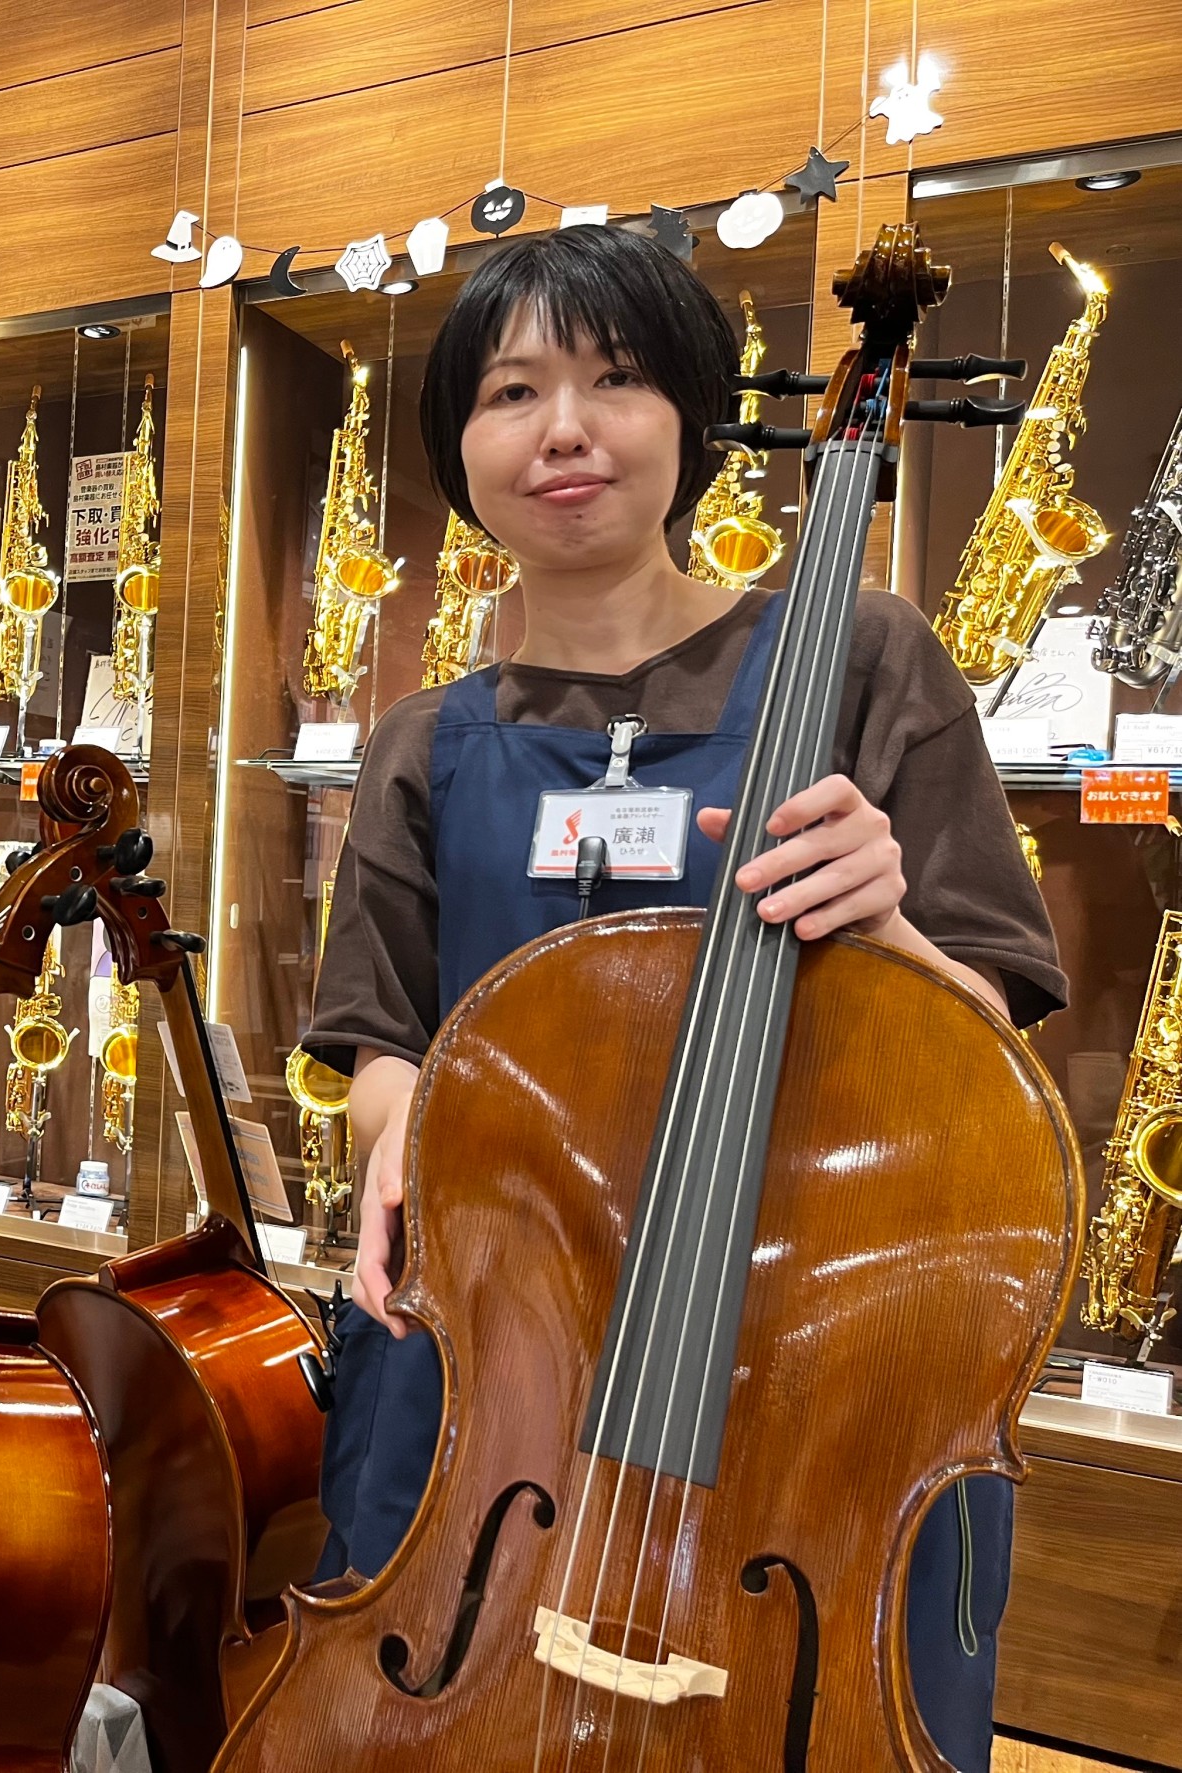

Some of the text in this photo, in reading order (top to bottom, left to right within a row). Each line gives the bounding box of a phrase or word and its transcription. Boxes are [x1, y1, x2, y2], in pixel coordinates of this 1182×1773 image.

[1086, 791, 1163, 801] お試しできます
[612, 826, 656, 844] 廣瀬
[619, 847, 645, 856] ひろせ
